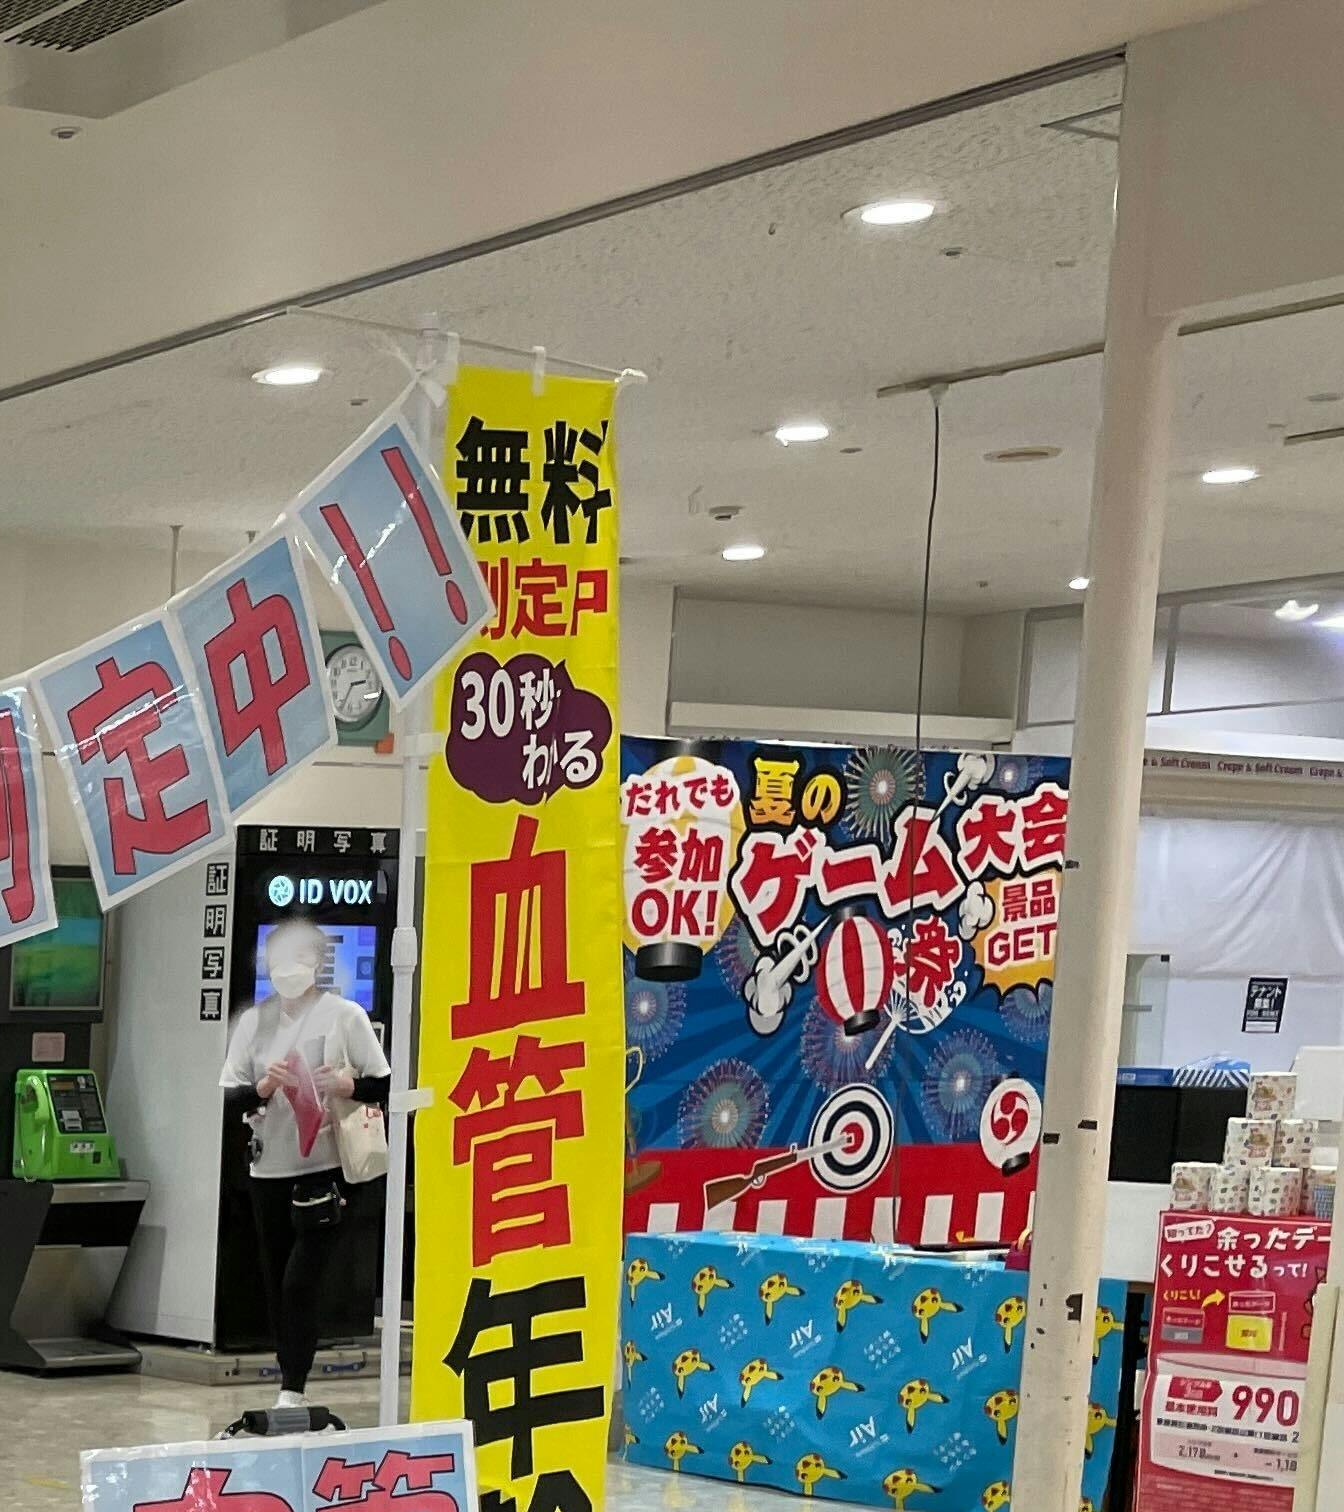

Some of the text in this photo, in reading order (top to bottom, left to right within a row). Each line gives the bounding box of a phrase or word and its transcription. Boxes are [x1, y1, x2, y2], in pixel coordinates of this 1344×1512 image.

[455, 415, 612, 545] 無料
[625, 773, 736, 817] だれでも
[750, 758, 842, 823] 夏の
[260, 829, 387, 853] 証明写真
[633, 827, 724, 883] 参加
[298, 878, 374, 905] ID VOX
[631, 889, 718, 937] OK!
[1002, 878, 1057, 919] 景品
[201, 864, 228, 1019] 証明写真
[987, 926, 1058, 966] GET
[1231, 1384, 1300, 1427] 990
